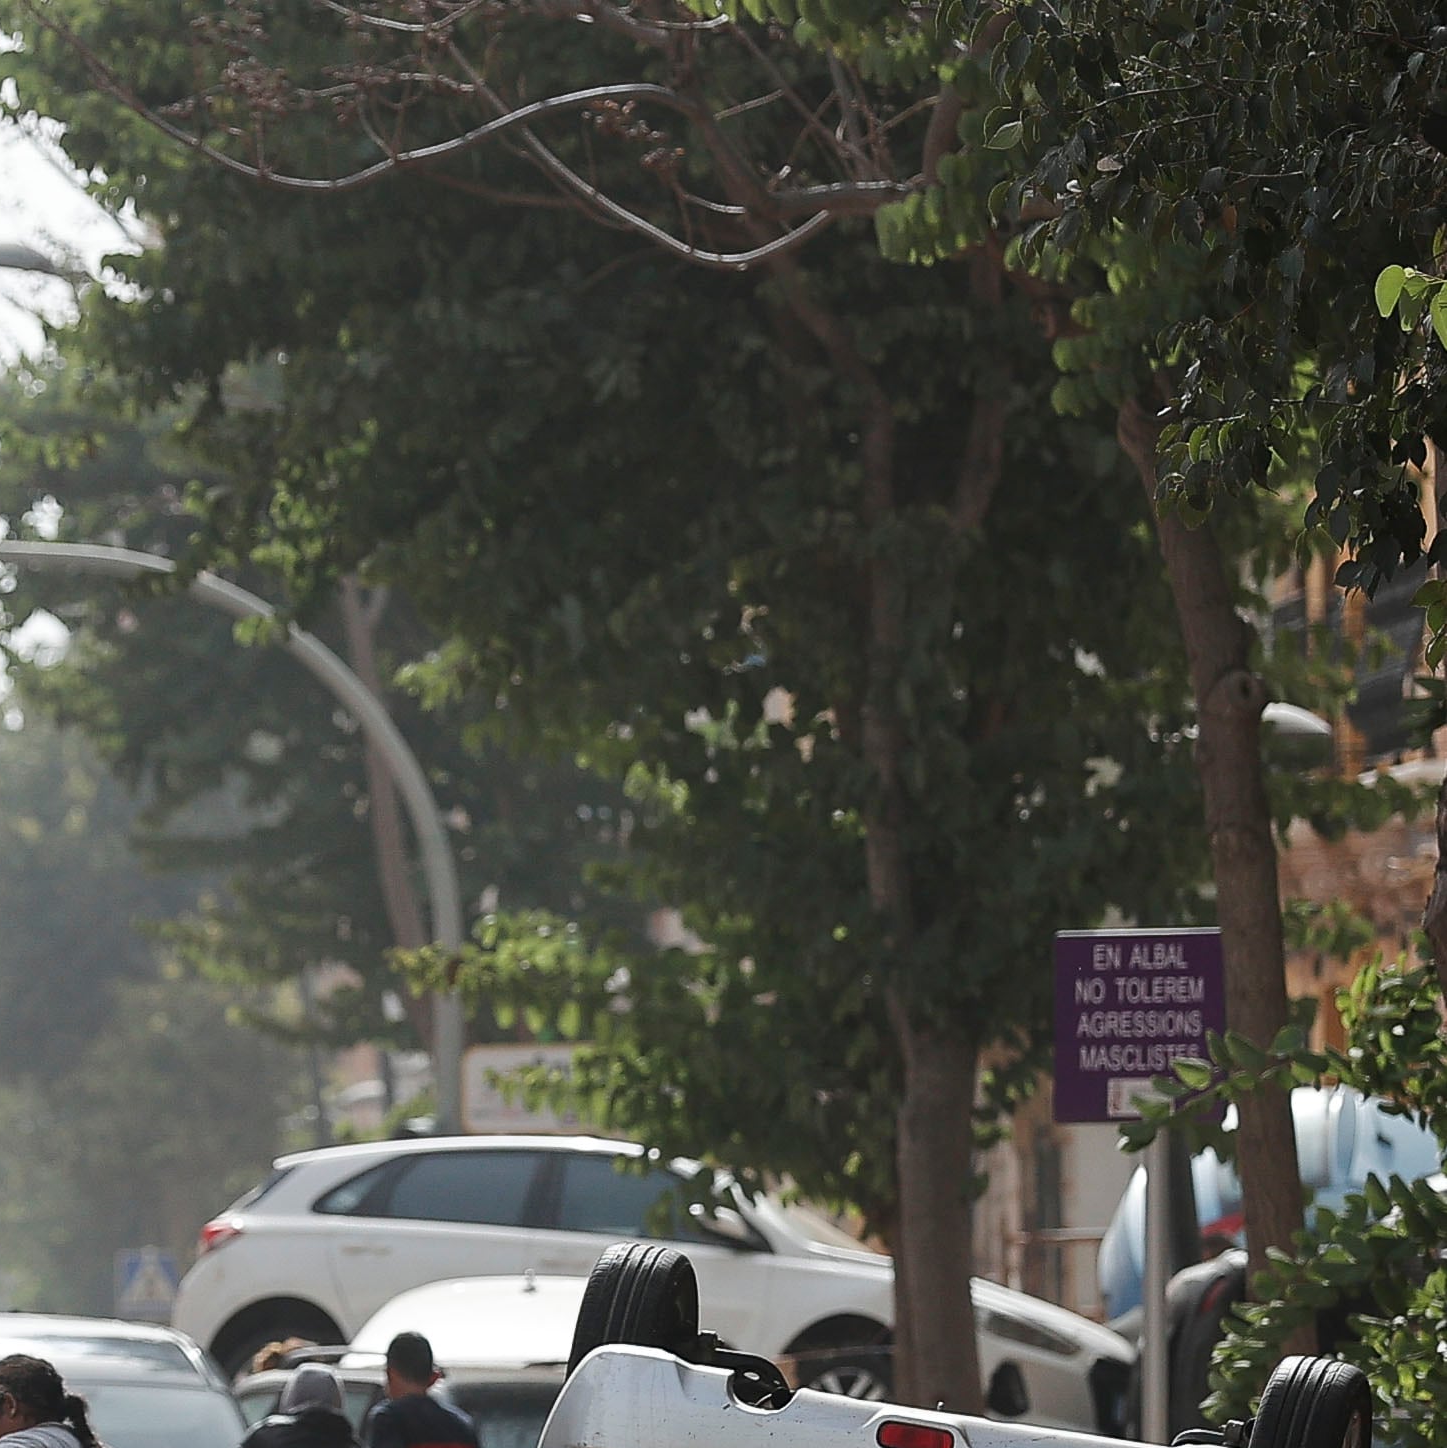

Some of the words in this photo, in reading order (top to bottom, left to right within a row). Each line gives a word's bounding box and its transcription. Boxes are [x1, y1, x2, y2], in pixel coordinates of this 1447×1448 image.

[1093, 944, 1122, 971] EN
[1129, 943, 1188, 970] ALBAL
[1075, 977, 1105, 1005] NO
[1115, 976, 1205, 1004] TOLEREM
[1076, 1010, 1203, 1038] AGRESSIONS
